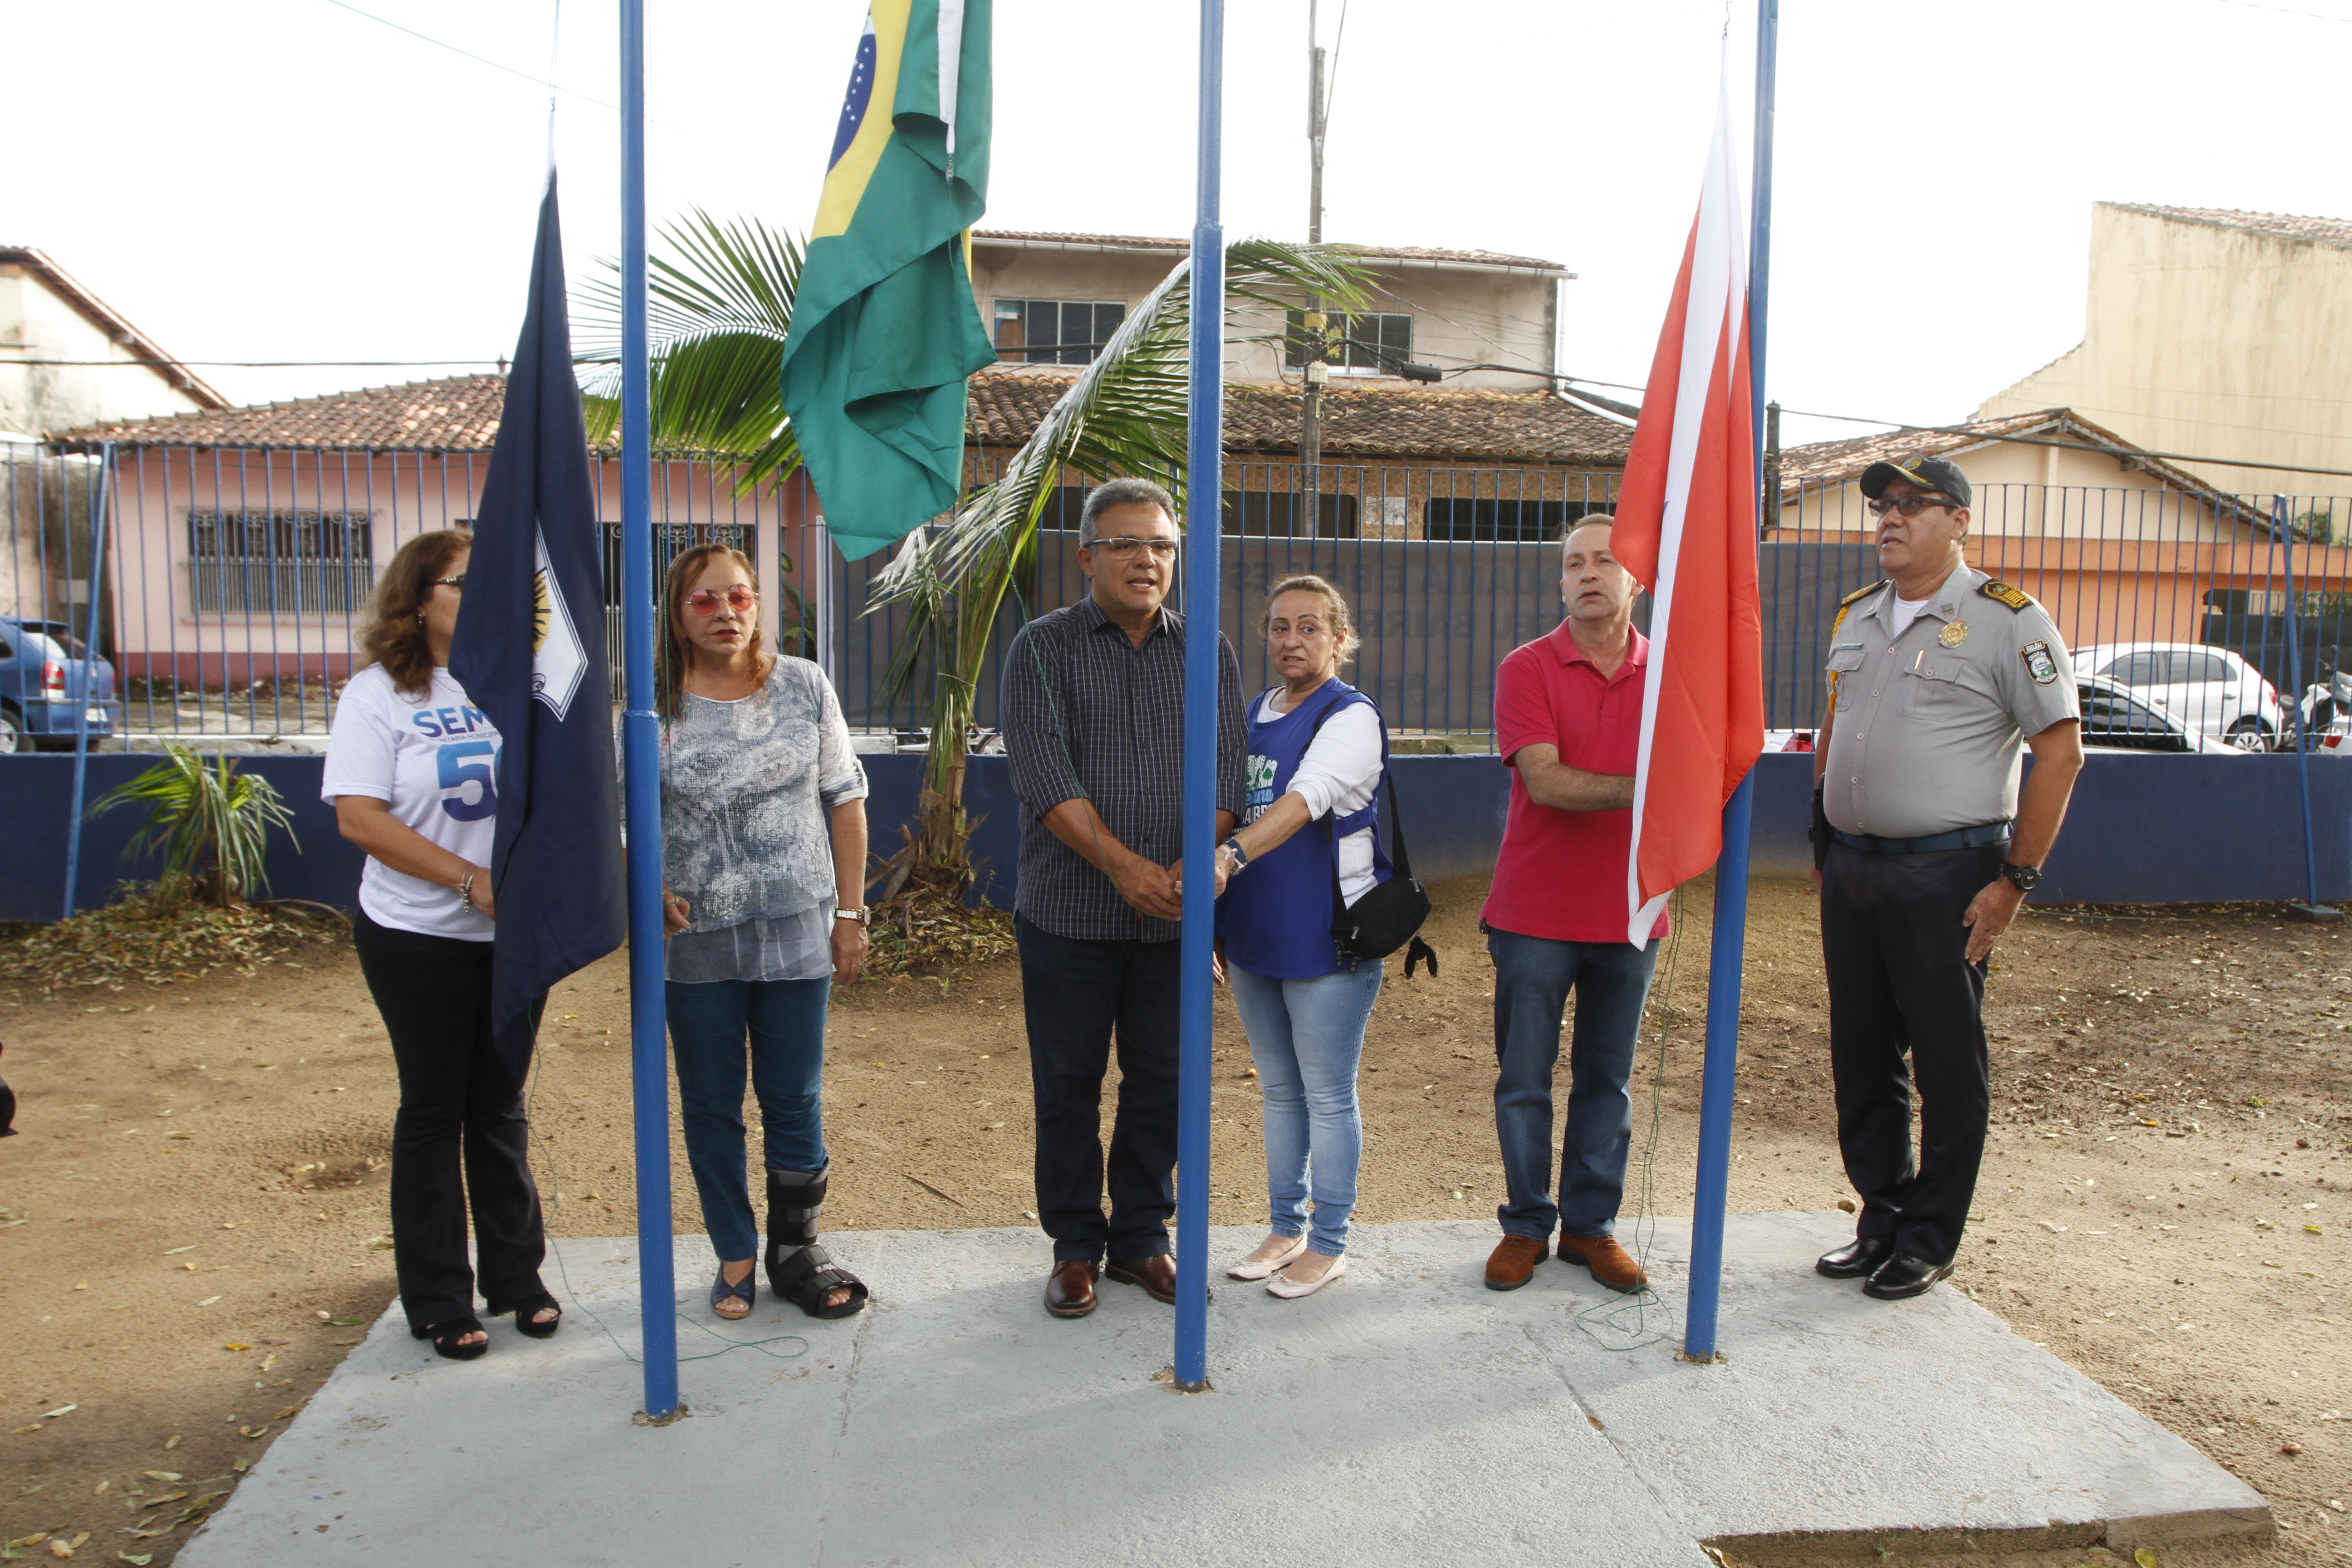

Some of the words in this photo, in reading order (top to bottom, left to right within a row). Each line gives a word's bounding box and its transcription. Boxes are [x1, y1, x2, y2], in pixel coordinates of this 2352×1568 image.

[2028, 651, 2046, 661] GUARDA
[2035, 672, 2057, 683] MUNICIPAL
[467, 730, 499, 739] MUNICIPA
[436, 740, 502, 822] 5
